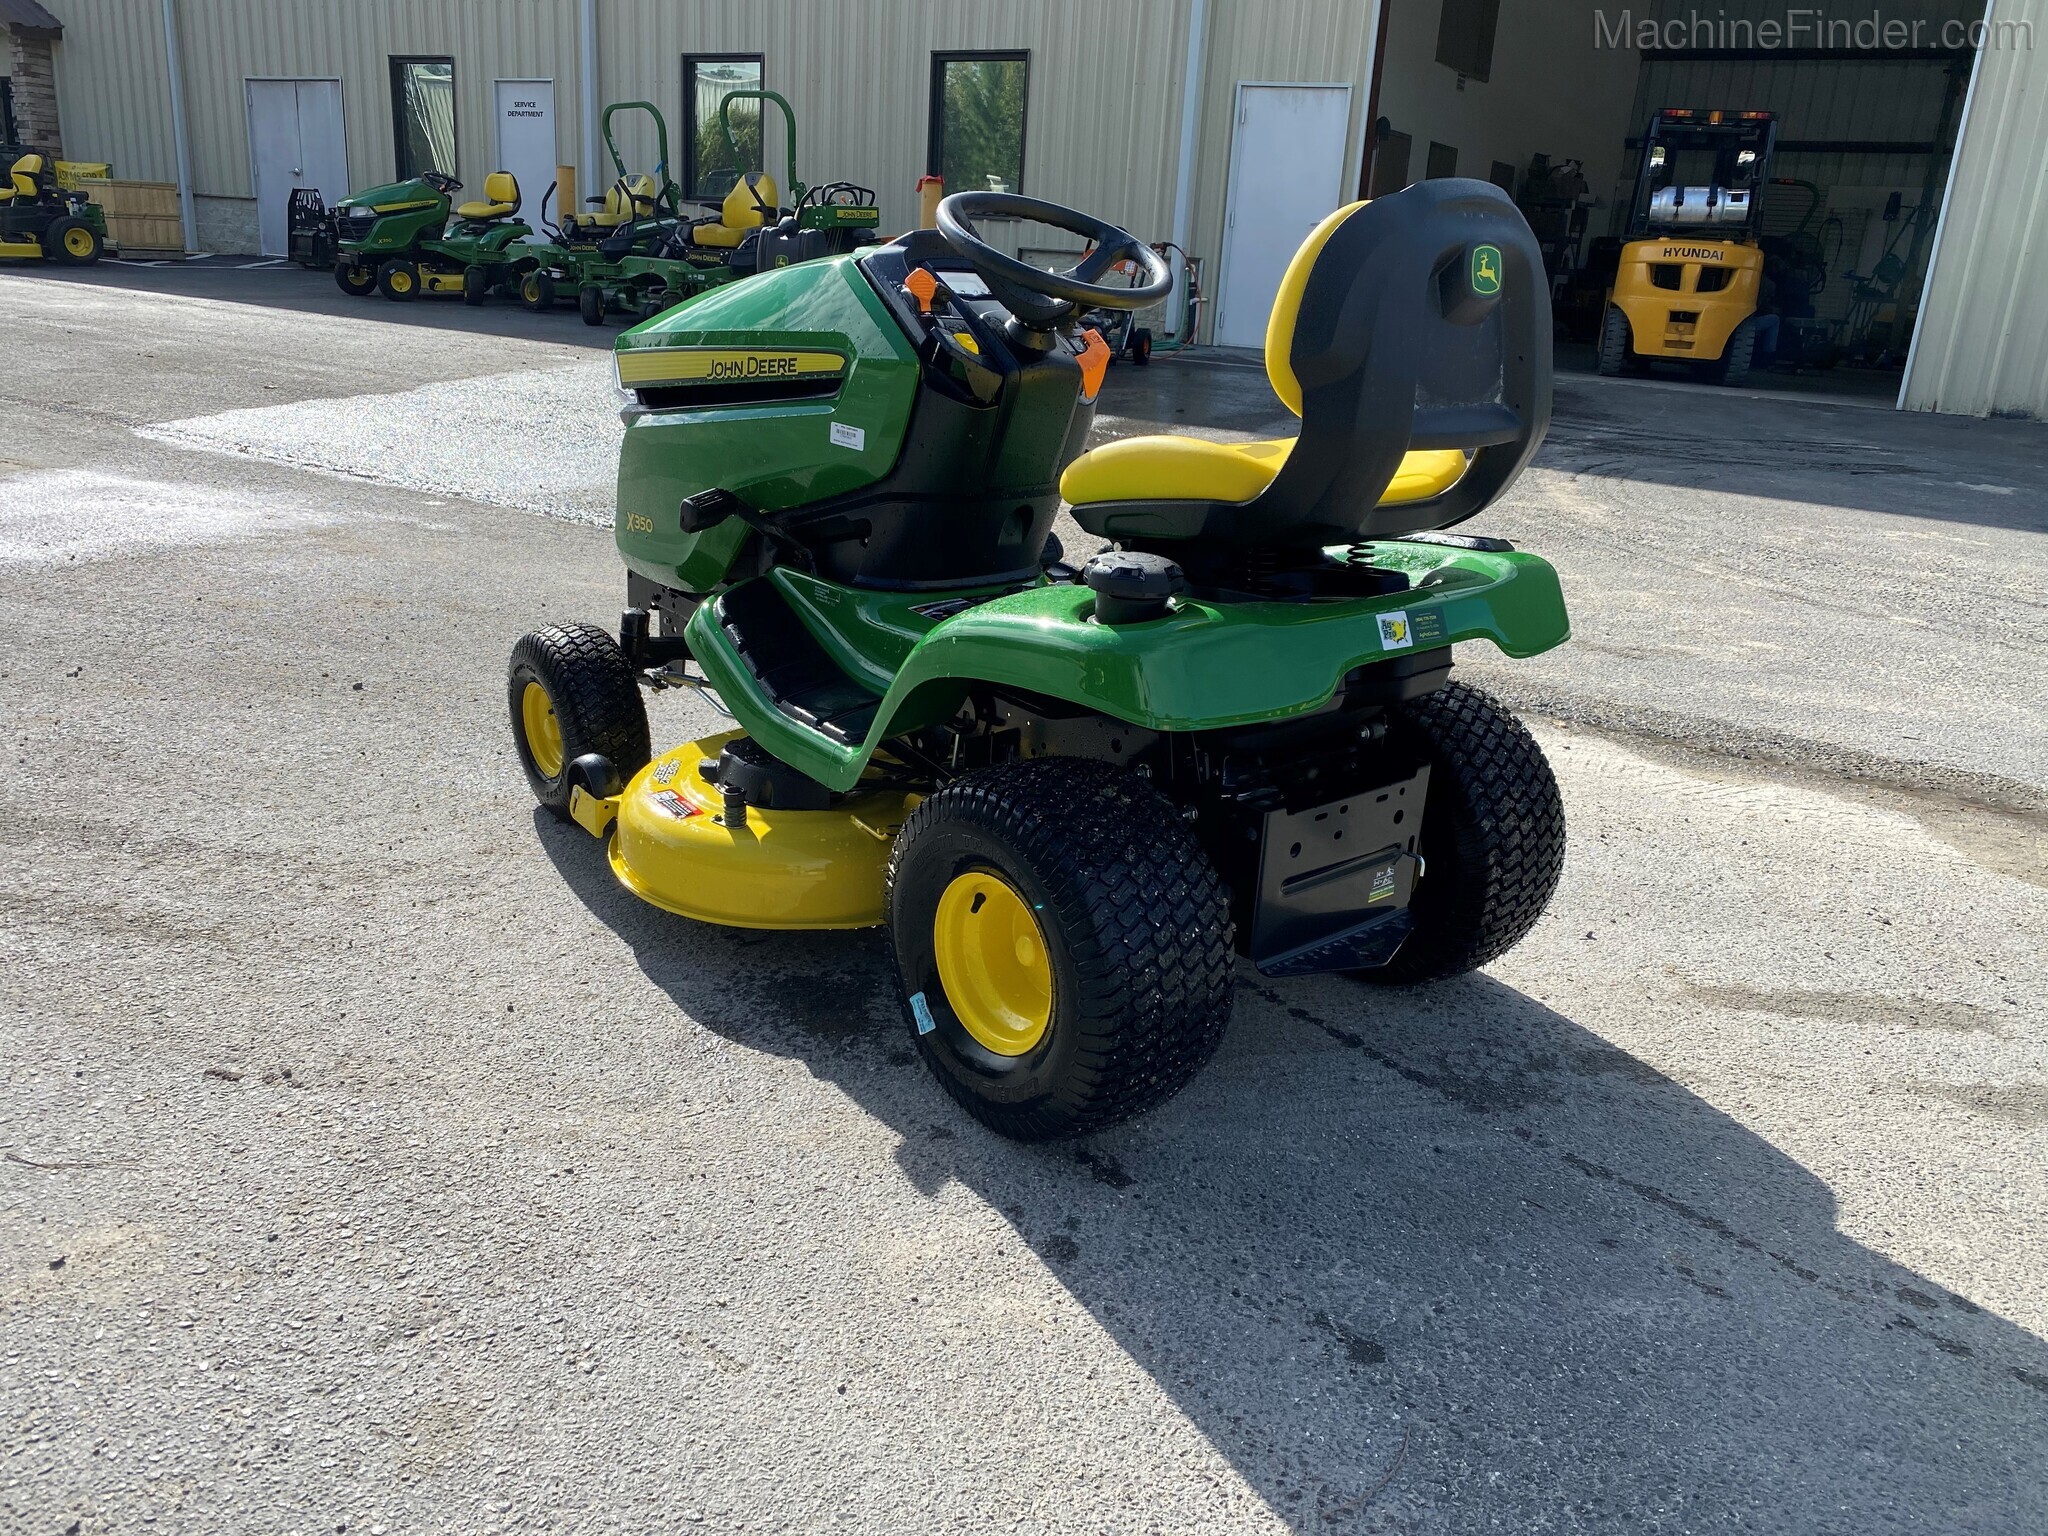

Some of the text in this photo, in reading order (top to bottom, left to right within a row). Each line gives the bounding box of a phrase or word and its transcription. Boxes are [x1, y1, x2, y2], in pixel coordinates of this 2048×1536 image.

[507, 110, 544, 118] DEPARTMENT
[688, 253, 720, 262] JOHN DEERE
[1663, 247, 1724, 261] HYUNDAI
[706, 356, 798, 378] JOHN DEERE
[626, 511, 653, 533] X350
